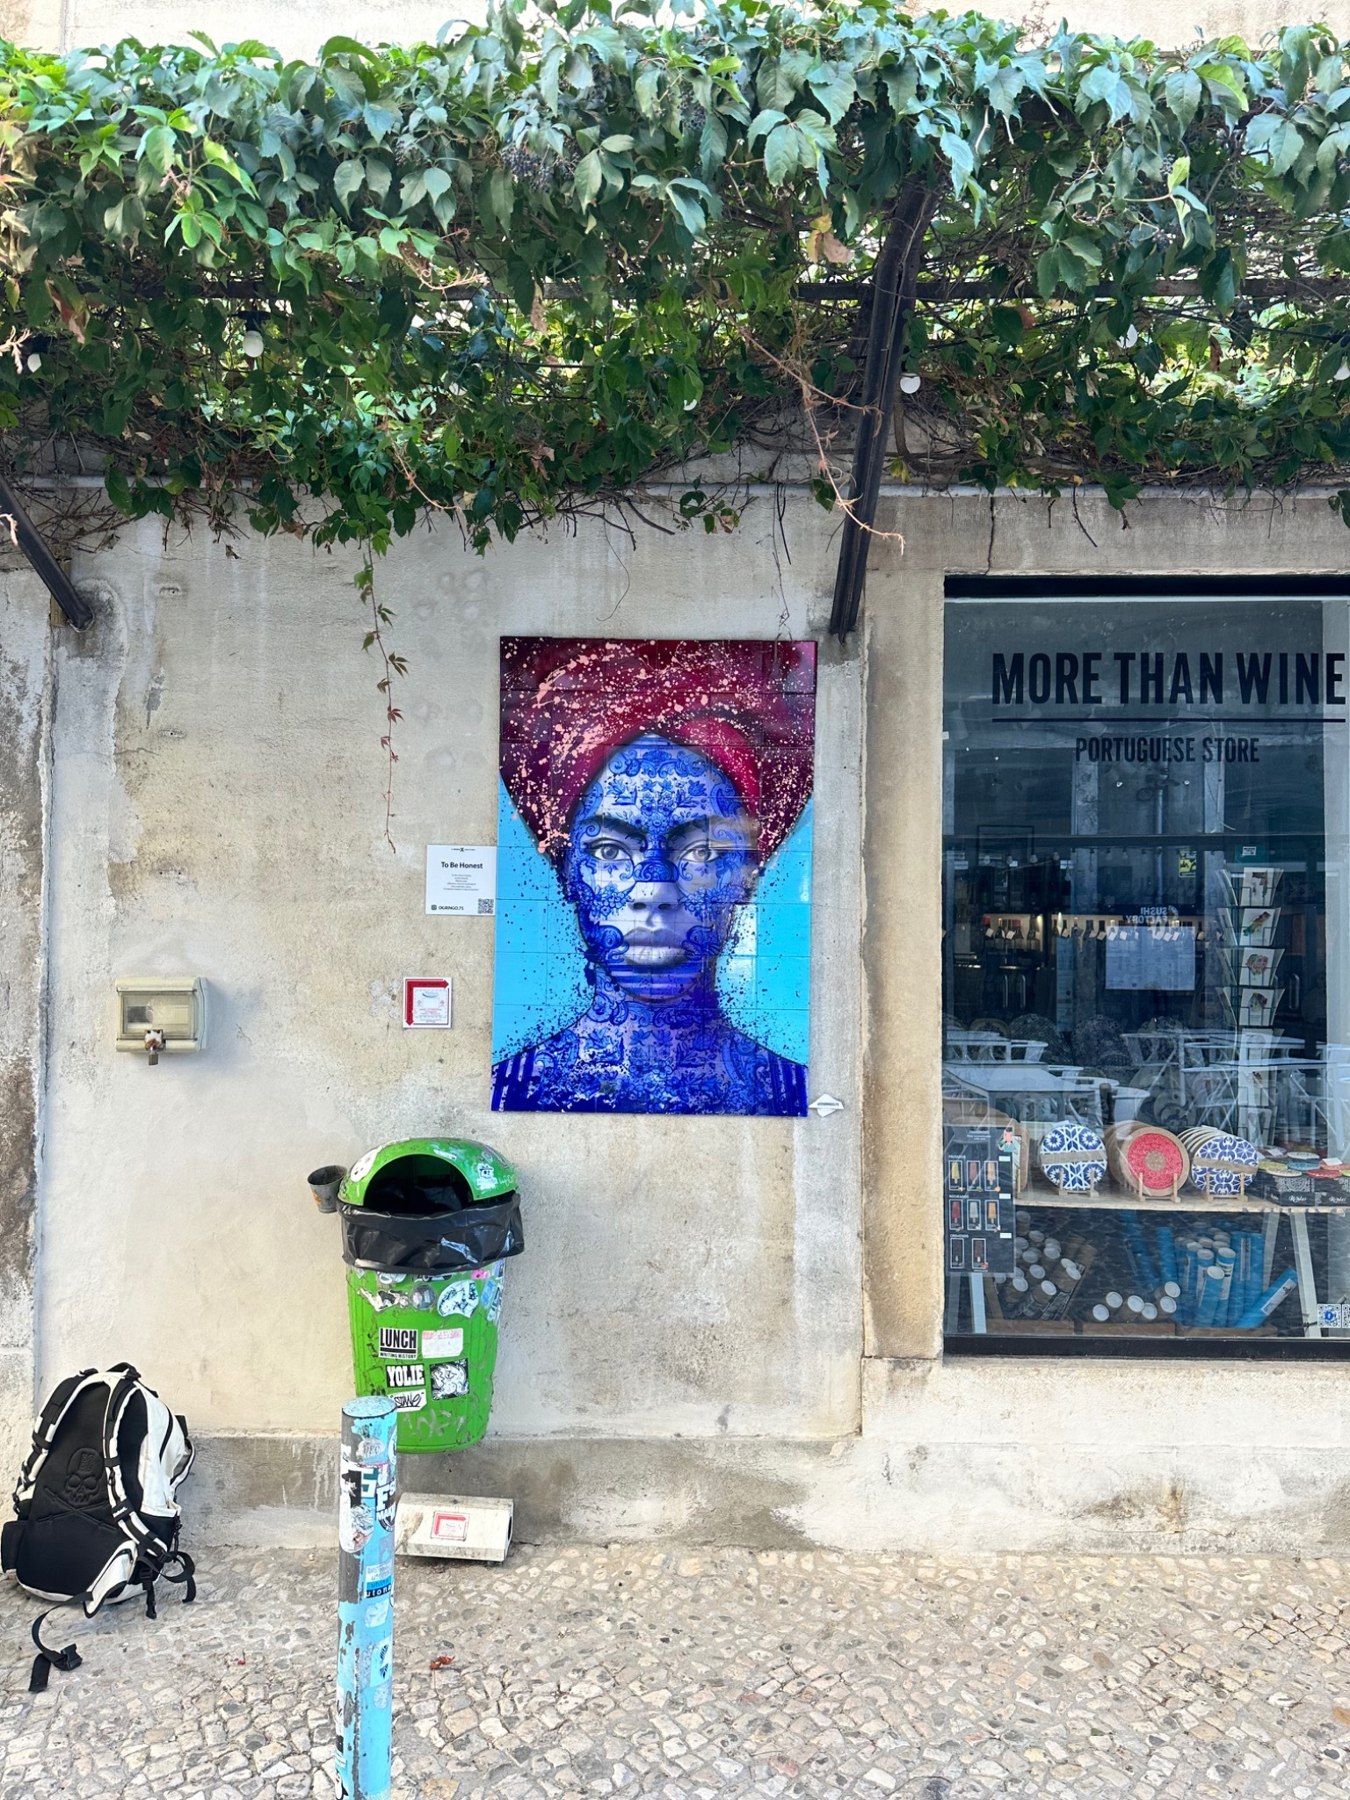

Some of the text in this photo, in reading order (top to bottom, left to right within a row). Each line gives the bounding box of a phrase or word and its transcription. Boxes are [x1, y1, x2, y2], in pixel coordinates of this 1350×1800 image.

[992, 653, 1346, 704] MORE THAN WINE
[1076, 737, 1259, 762] PORTUGUESE STORE
[450, 861, 458, 869] Be
[380, 1328, 417, 1348] LUNCH
[387, 1364, 425, 1387] YOLIE
